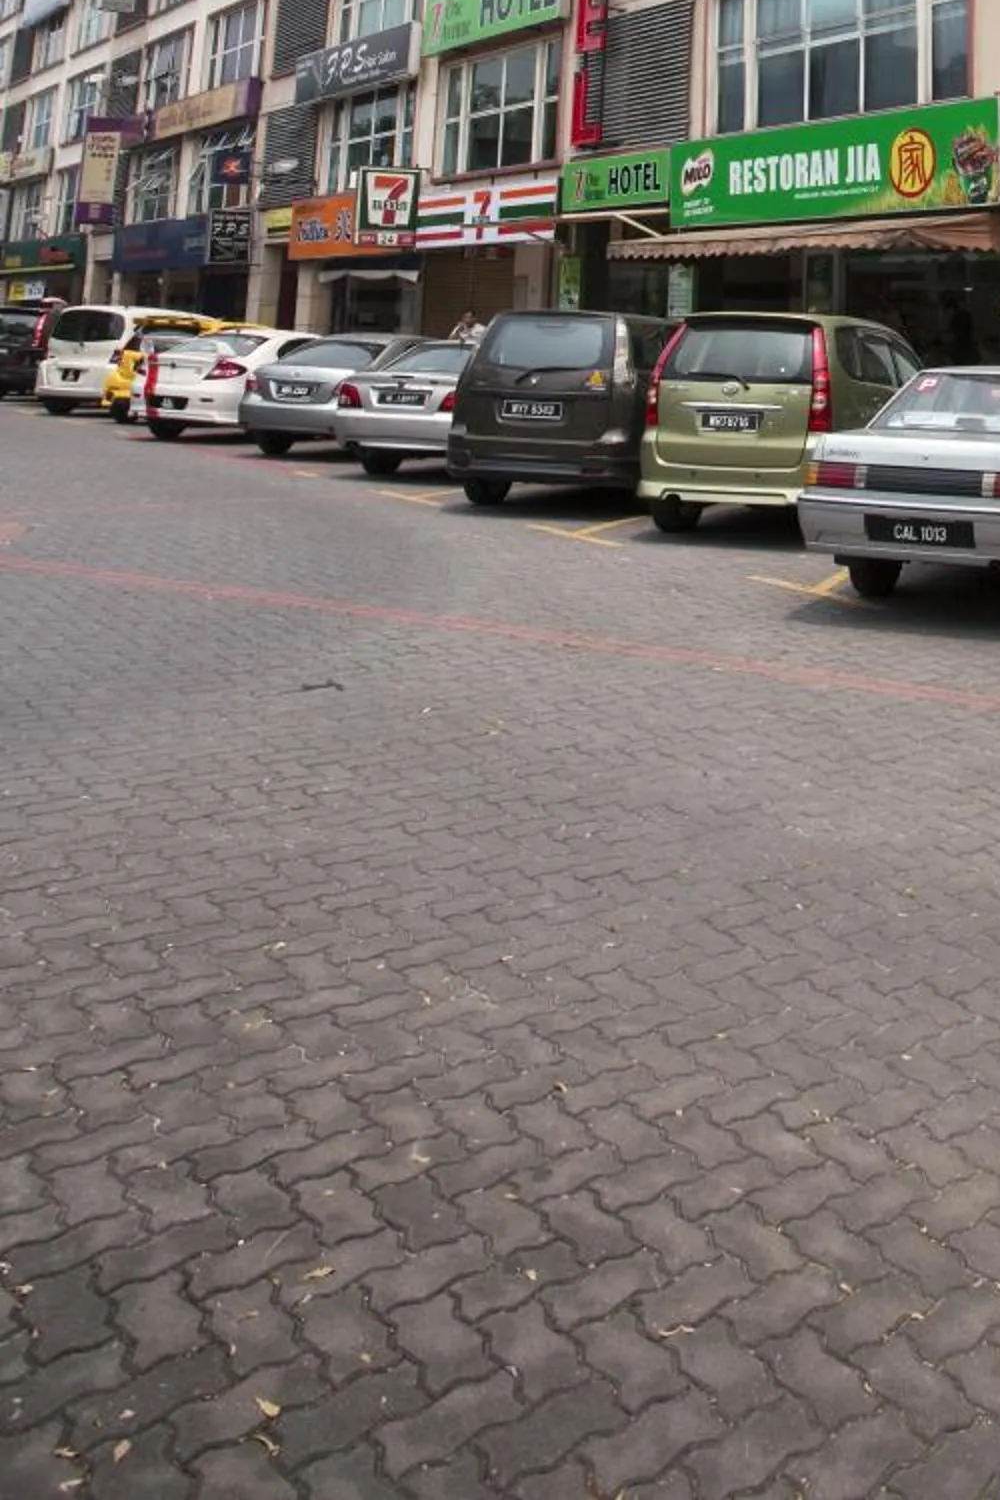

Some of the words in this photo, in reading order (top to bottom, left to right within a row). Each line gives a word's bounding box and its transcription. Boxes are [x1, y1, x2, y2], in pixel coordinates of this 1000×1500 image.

[608, 162, 661, 196] HOTEL
[684, 163, 711, 186] MILO
[729, 149, 839, 196] RESTORAN
[845, 143, 882, 183] JIA
[898, 138, 926, 186] 家
[894, 524, 918, 541] CAL
[920, 527, 947, 542] 1013
